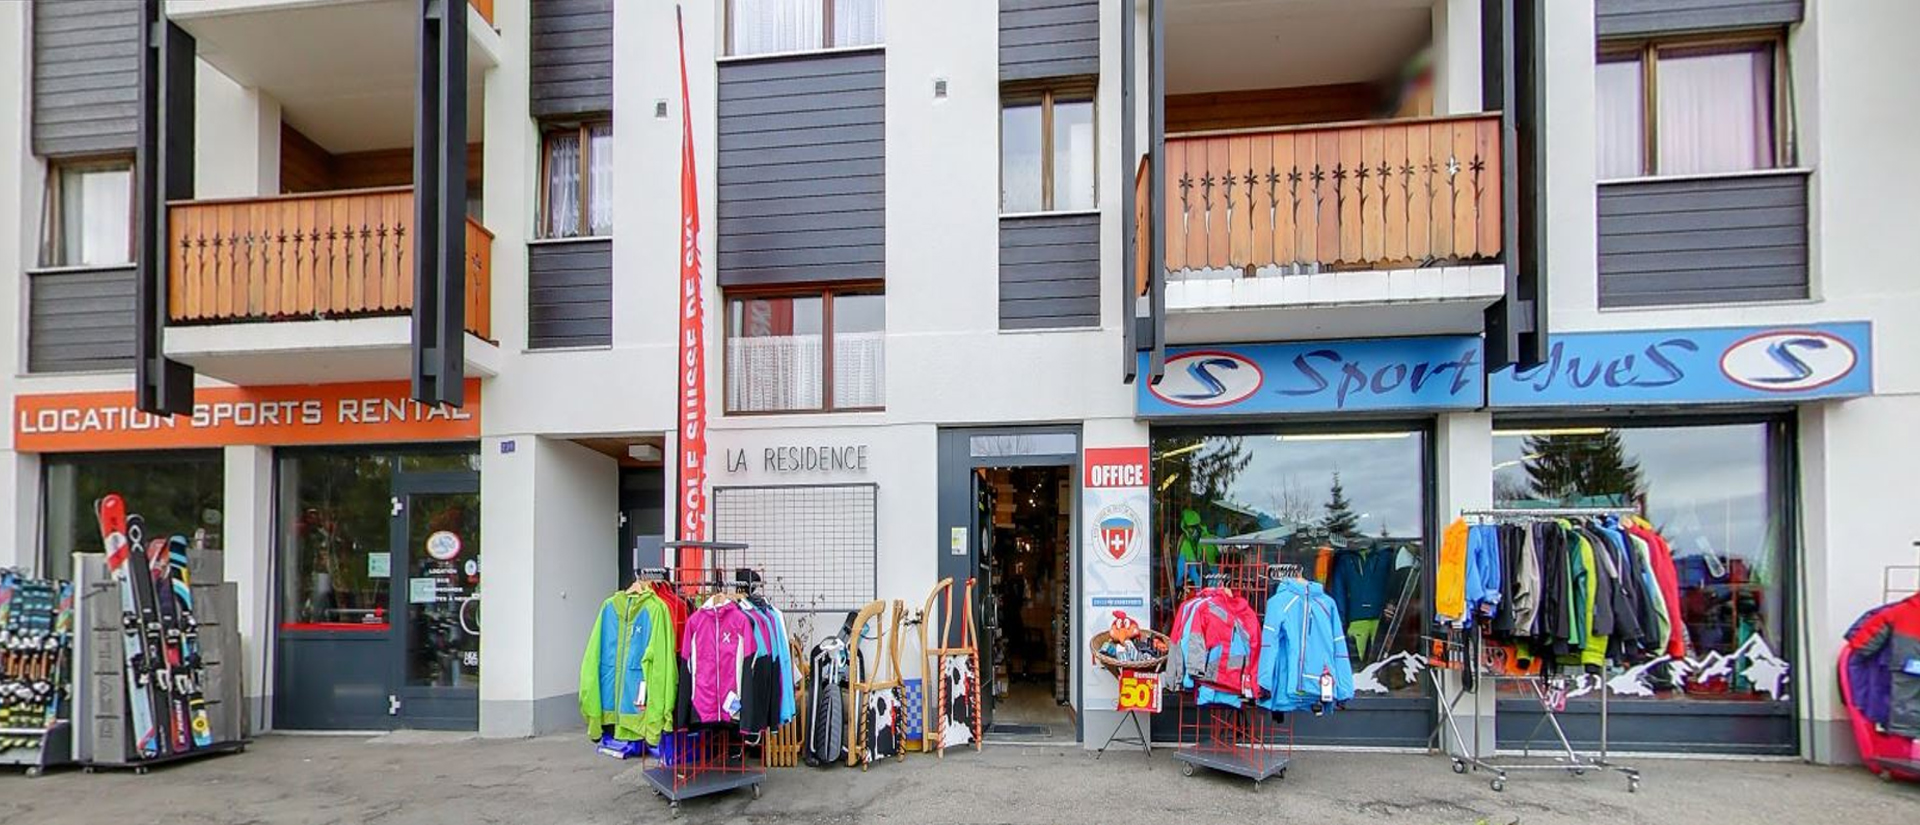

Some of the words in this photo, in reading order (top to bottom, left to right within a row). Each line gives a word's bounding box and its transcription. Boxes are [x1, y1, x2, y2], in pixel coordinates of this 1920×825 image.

[1275, 349, 1480, 409] Sport
[190, 400, 322, 428] SPORTS
[726, 448, 748, 472] LA
[764, 445, 868, 472] RESIDENCE
[1091, 464, 1144, 486] OFFICE
